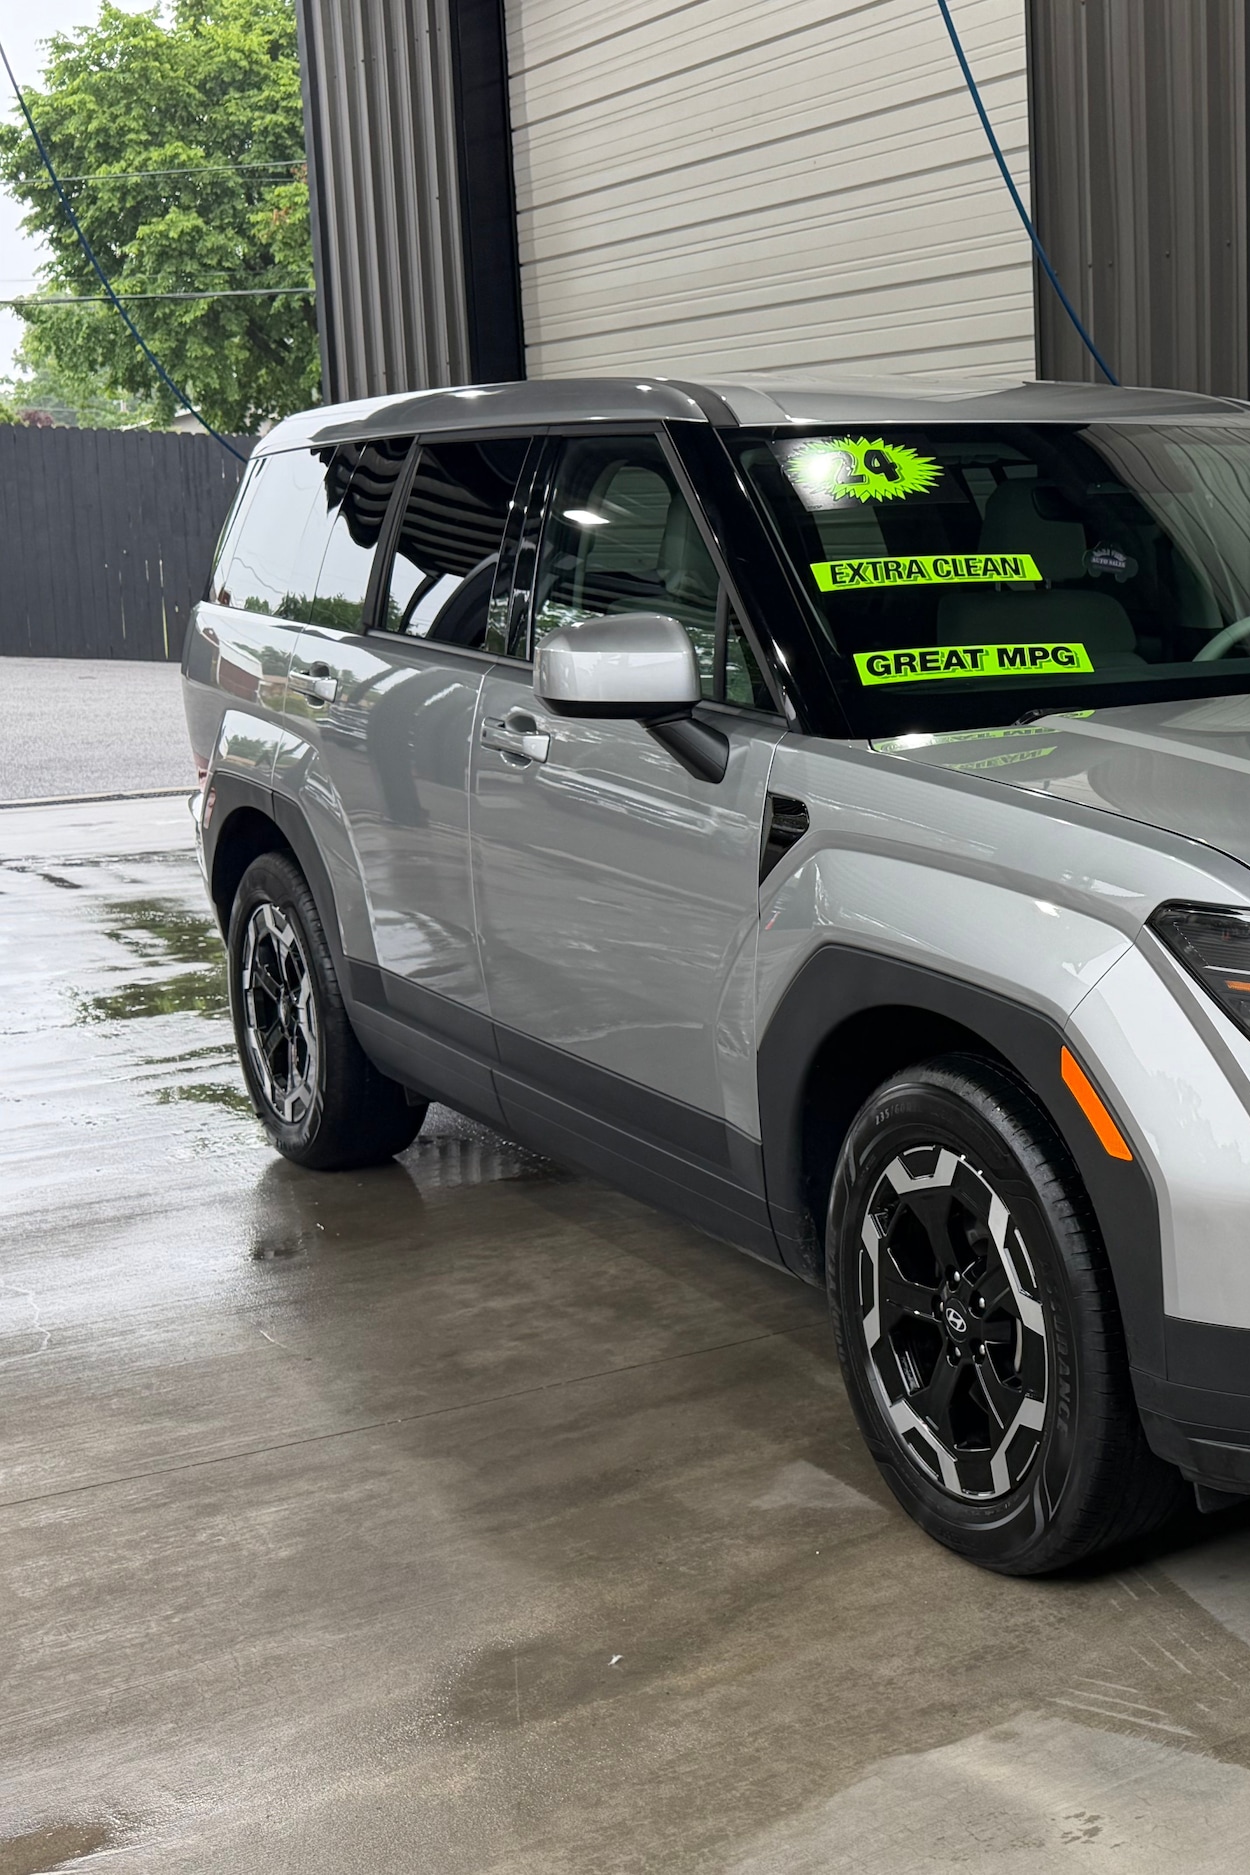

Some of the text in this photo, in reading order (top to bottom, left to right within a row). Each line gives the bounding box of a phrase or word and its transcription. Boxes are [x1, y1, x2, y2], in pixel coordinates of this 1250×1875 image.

[829, 449, 903, 485] 24
[830, 557, 1023, 586] EXTRA CLEAN
[866, 646, 1077, 677] GREAT MPG
